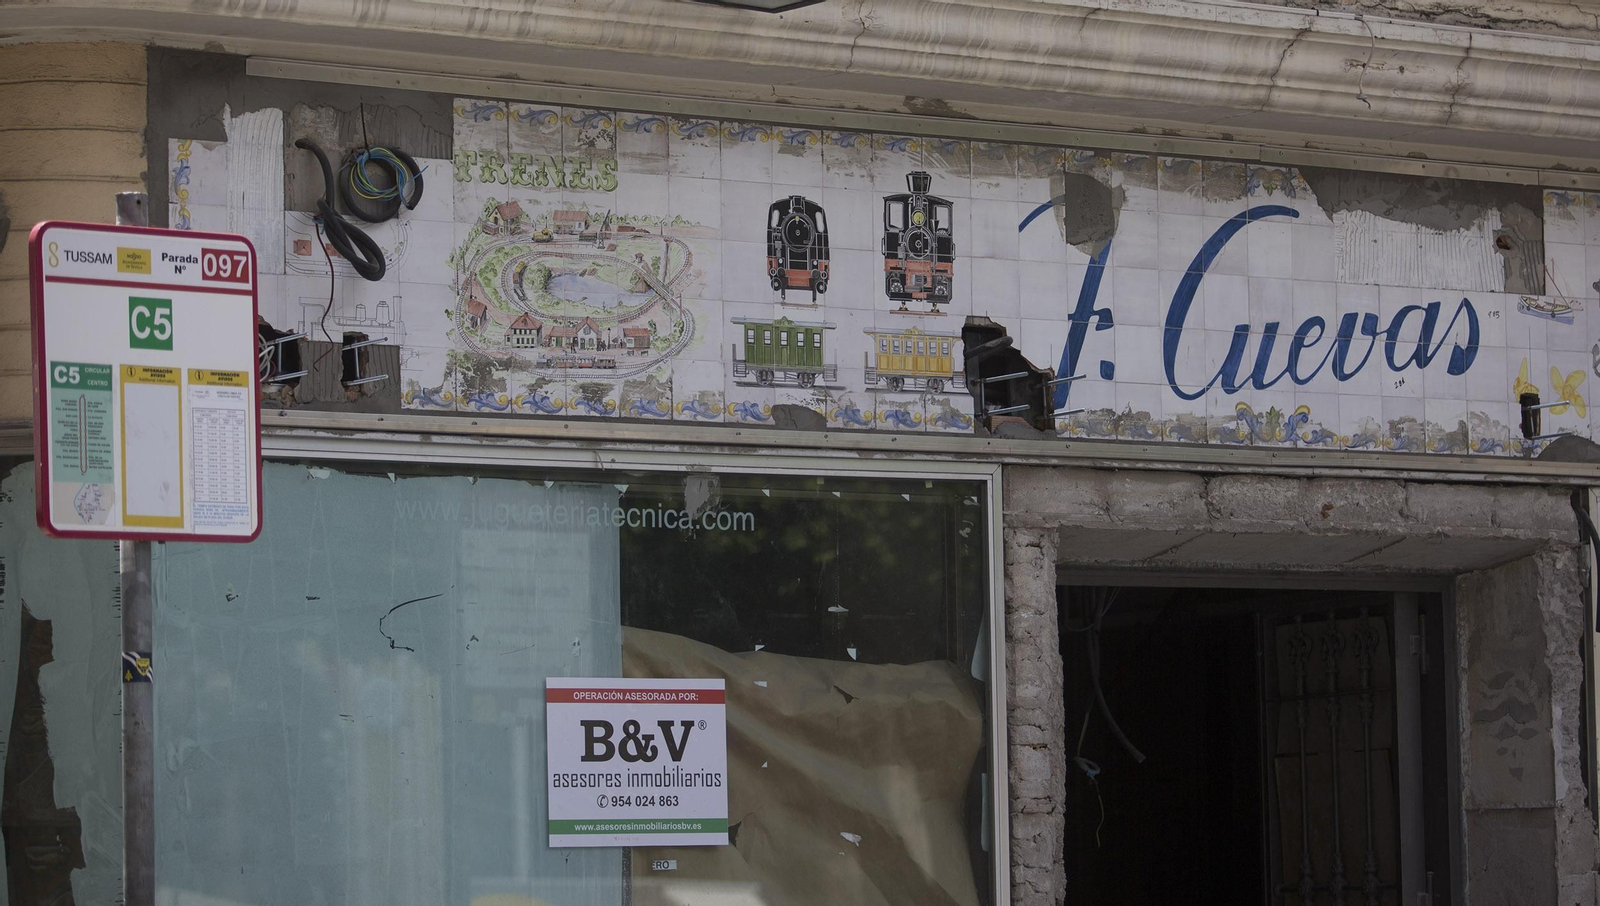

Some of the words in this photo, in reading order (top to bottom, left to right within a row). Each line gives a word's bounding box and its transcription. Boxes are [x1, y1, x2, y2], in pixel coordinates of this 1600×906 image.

[452, 149, 619, 193] TRENES
[63, 249, 113, 265] TUSSAM
[161, 252, 199, 265] Parada
[202, 252, 248, 278] 097
[1162, 204, 1481, 401] Cuevas
[130, 304, 172, 341] C5
[53, 365, 80, 384] C5
[397, 498, 756, 532] www.jugueteriatecnica.com
[573, 690, 623, 700] OPERACIÓN
[624, 691, 677, 701] ASESORADA
[678, 692, 699, 701] POR:
[580, 719, 695, 763] B&V
[553, 773, 622, 788] asesores
[627, 765, 722, 788] inmobiliarios
[611, 795, 632, 807] 954
[635, 795, 656, 807] 024
[658, 795, 679, 807] 863
[574, 821, 702, 832] www.asesoresinmobiliariosbv.es
